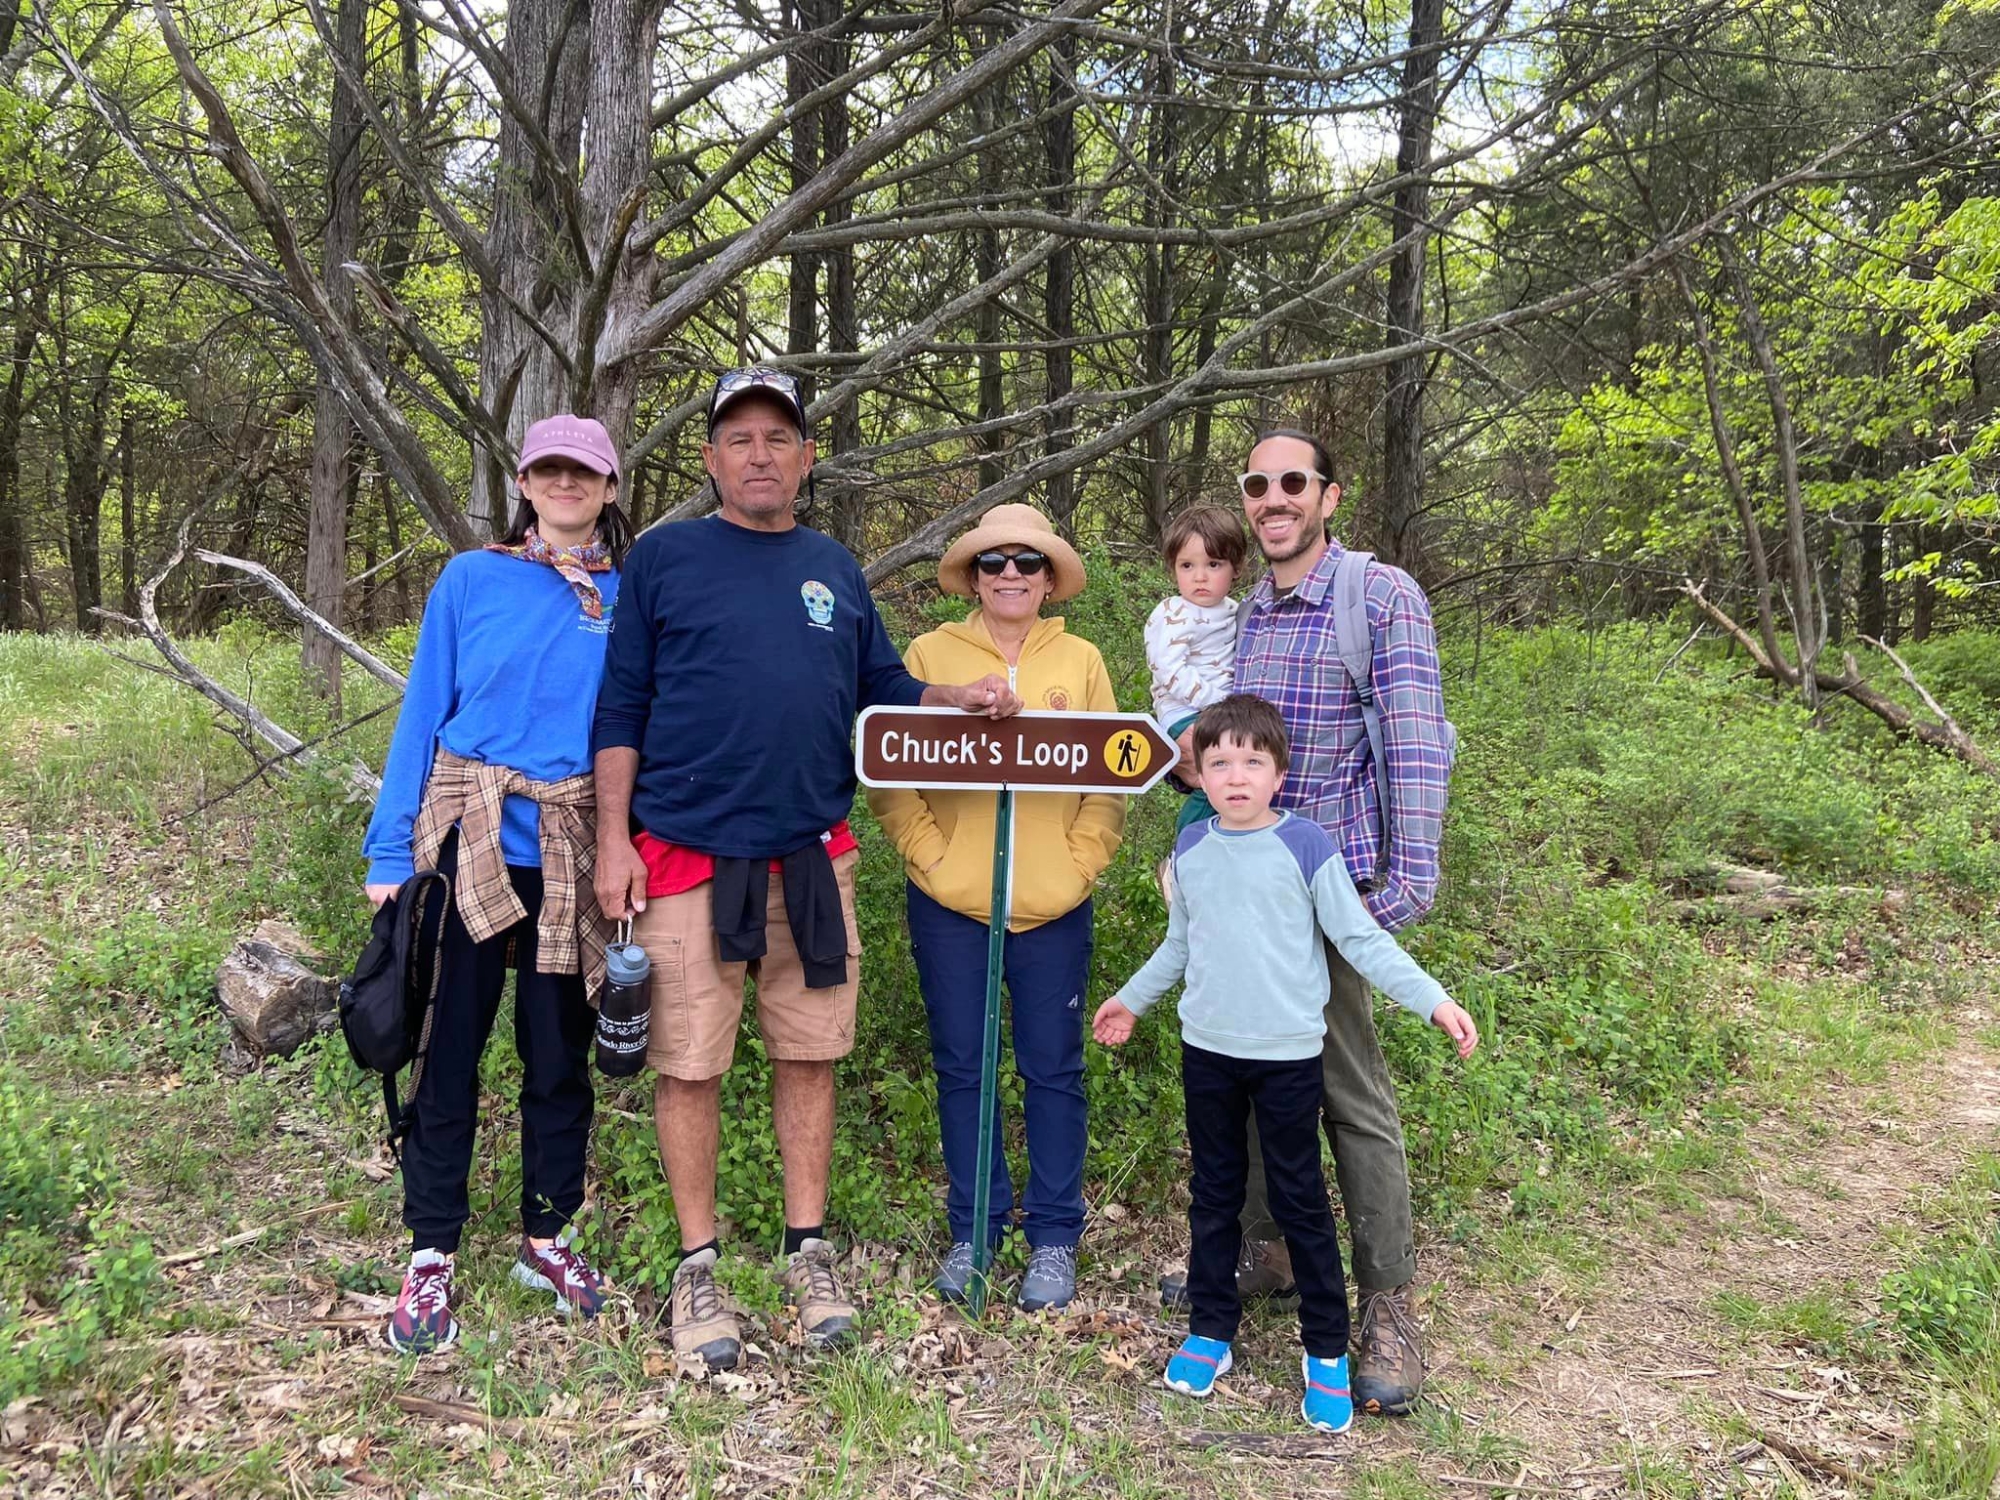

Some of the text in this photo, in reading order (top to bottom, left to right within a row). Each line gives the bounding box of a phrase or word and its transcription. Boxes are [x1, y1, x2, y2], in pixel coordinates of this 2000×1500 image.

[542, 430, 593, 443] ATHLETA
[881, 730, 1089, 774] Chuck's Loop
